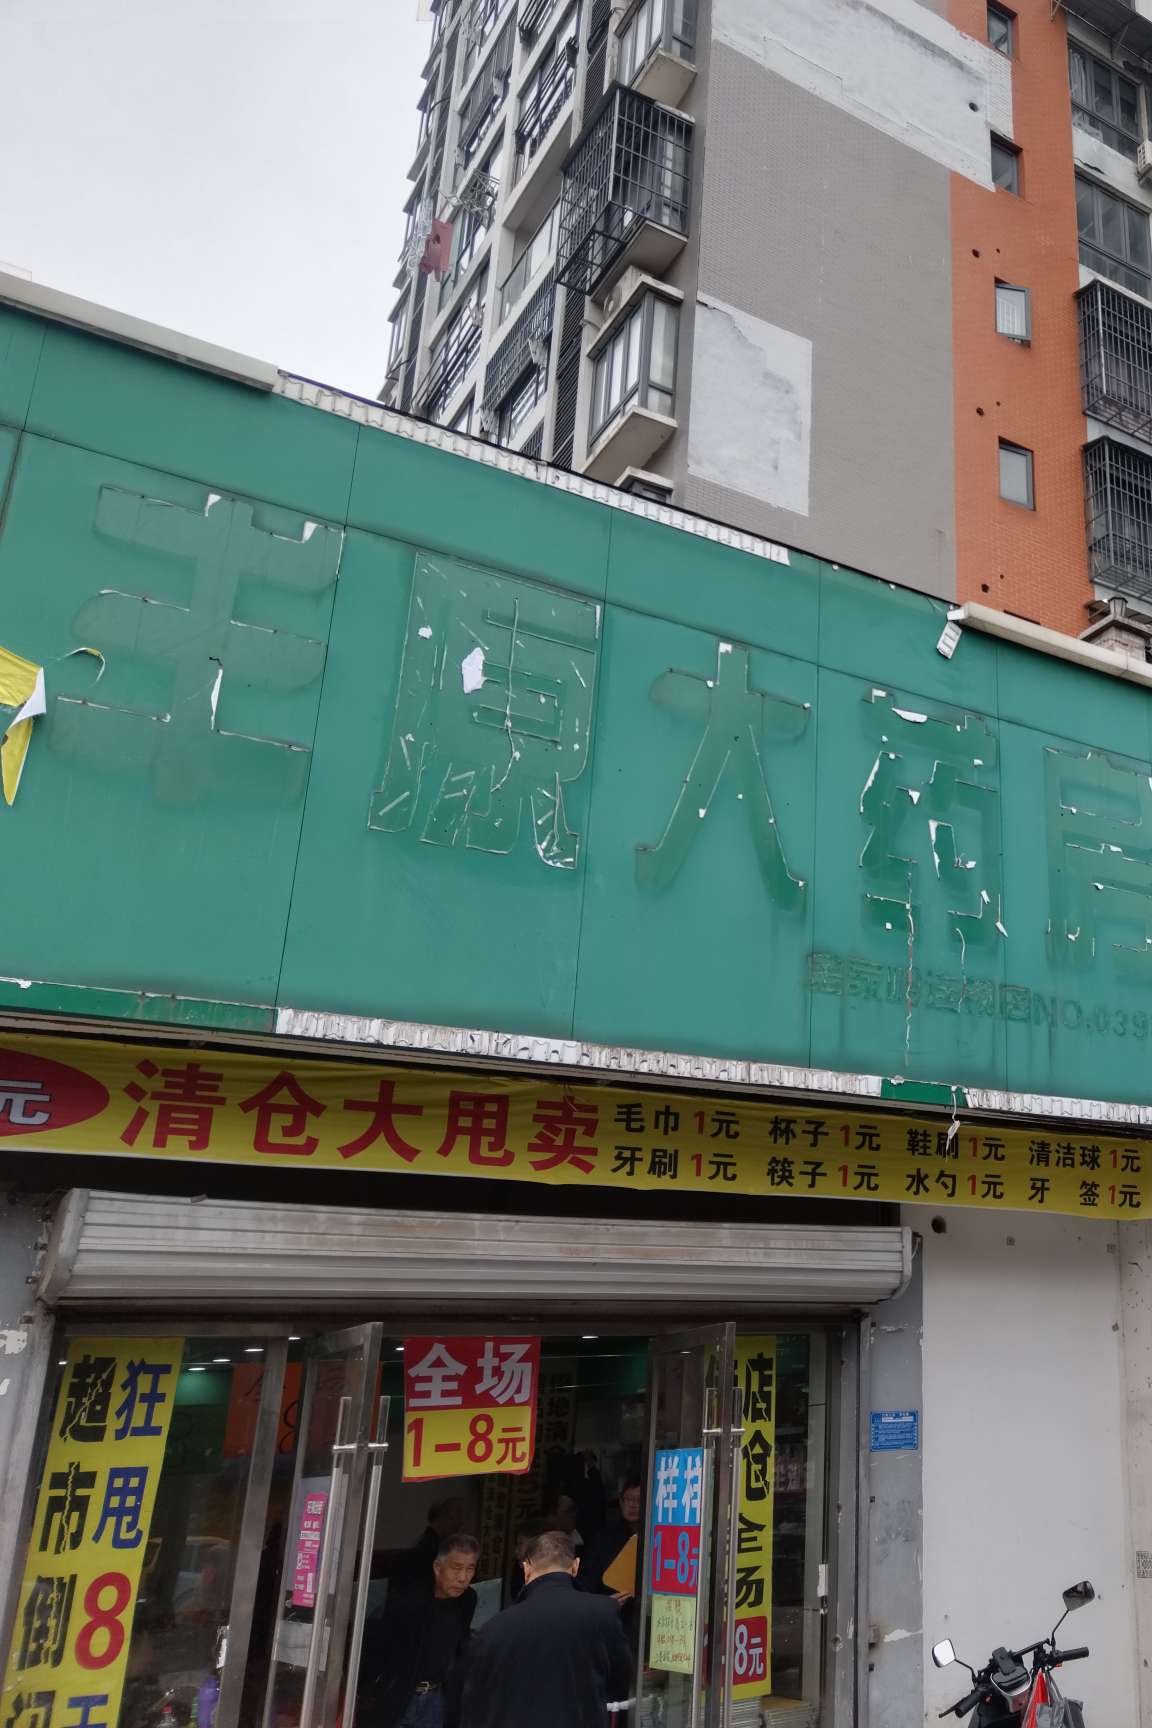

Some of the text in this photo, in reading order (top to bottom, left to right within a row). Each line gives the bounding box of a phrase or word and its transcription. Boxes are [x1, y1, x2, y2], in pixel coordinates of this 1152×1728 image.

[120, 1059, 598, 1175] 清仓大甩卖
[613, 1103, 1141, 1172] 毛巾1元 杯子1元 鞋刷1元 清洁球1元
[612, 1146, 1141, 1209] 牙刷1元 筷子1元 水勺1元 牙签1元
[408, 1342, 533, 1408] 全场
[407, 1412, 529, 1467] 1-8元
